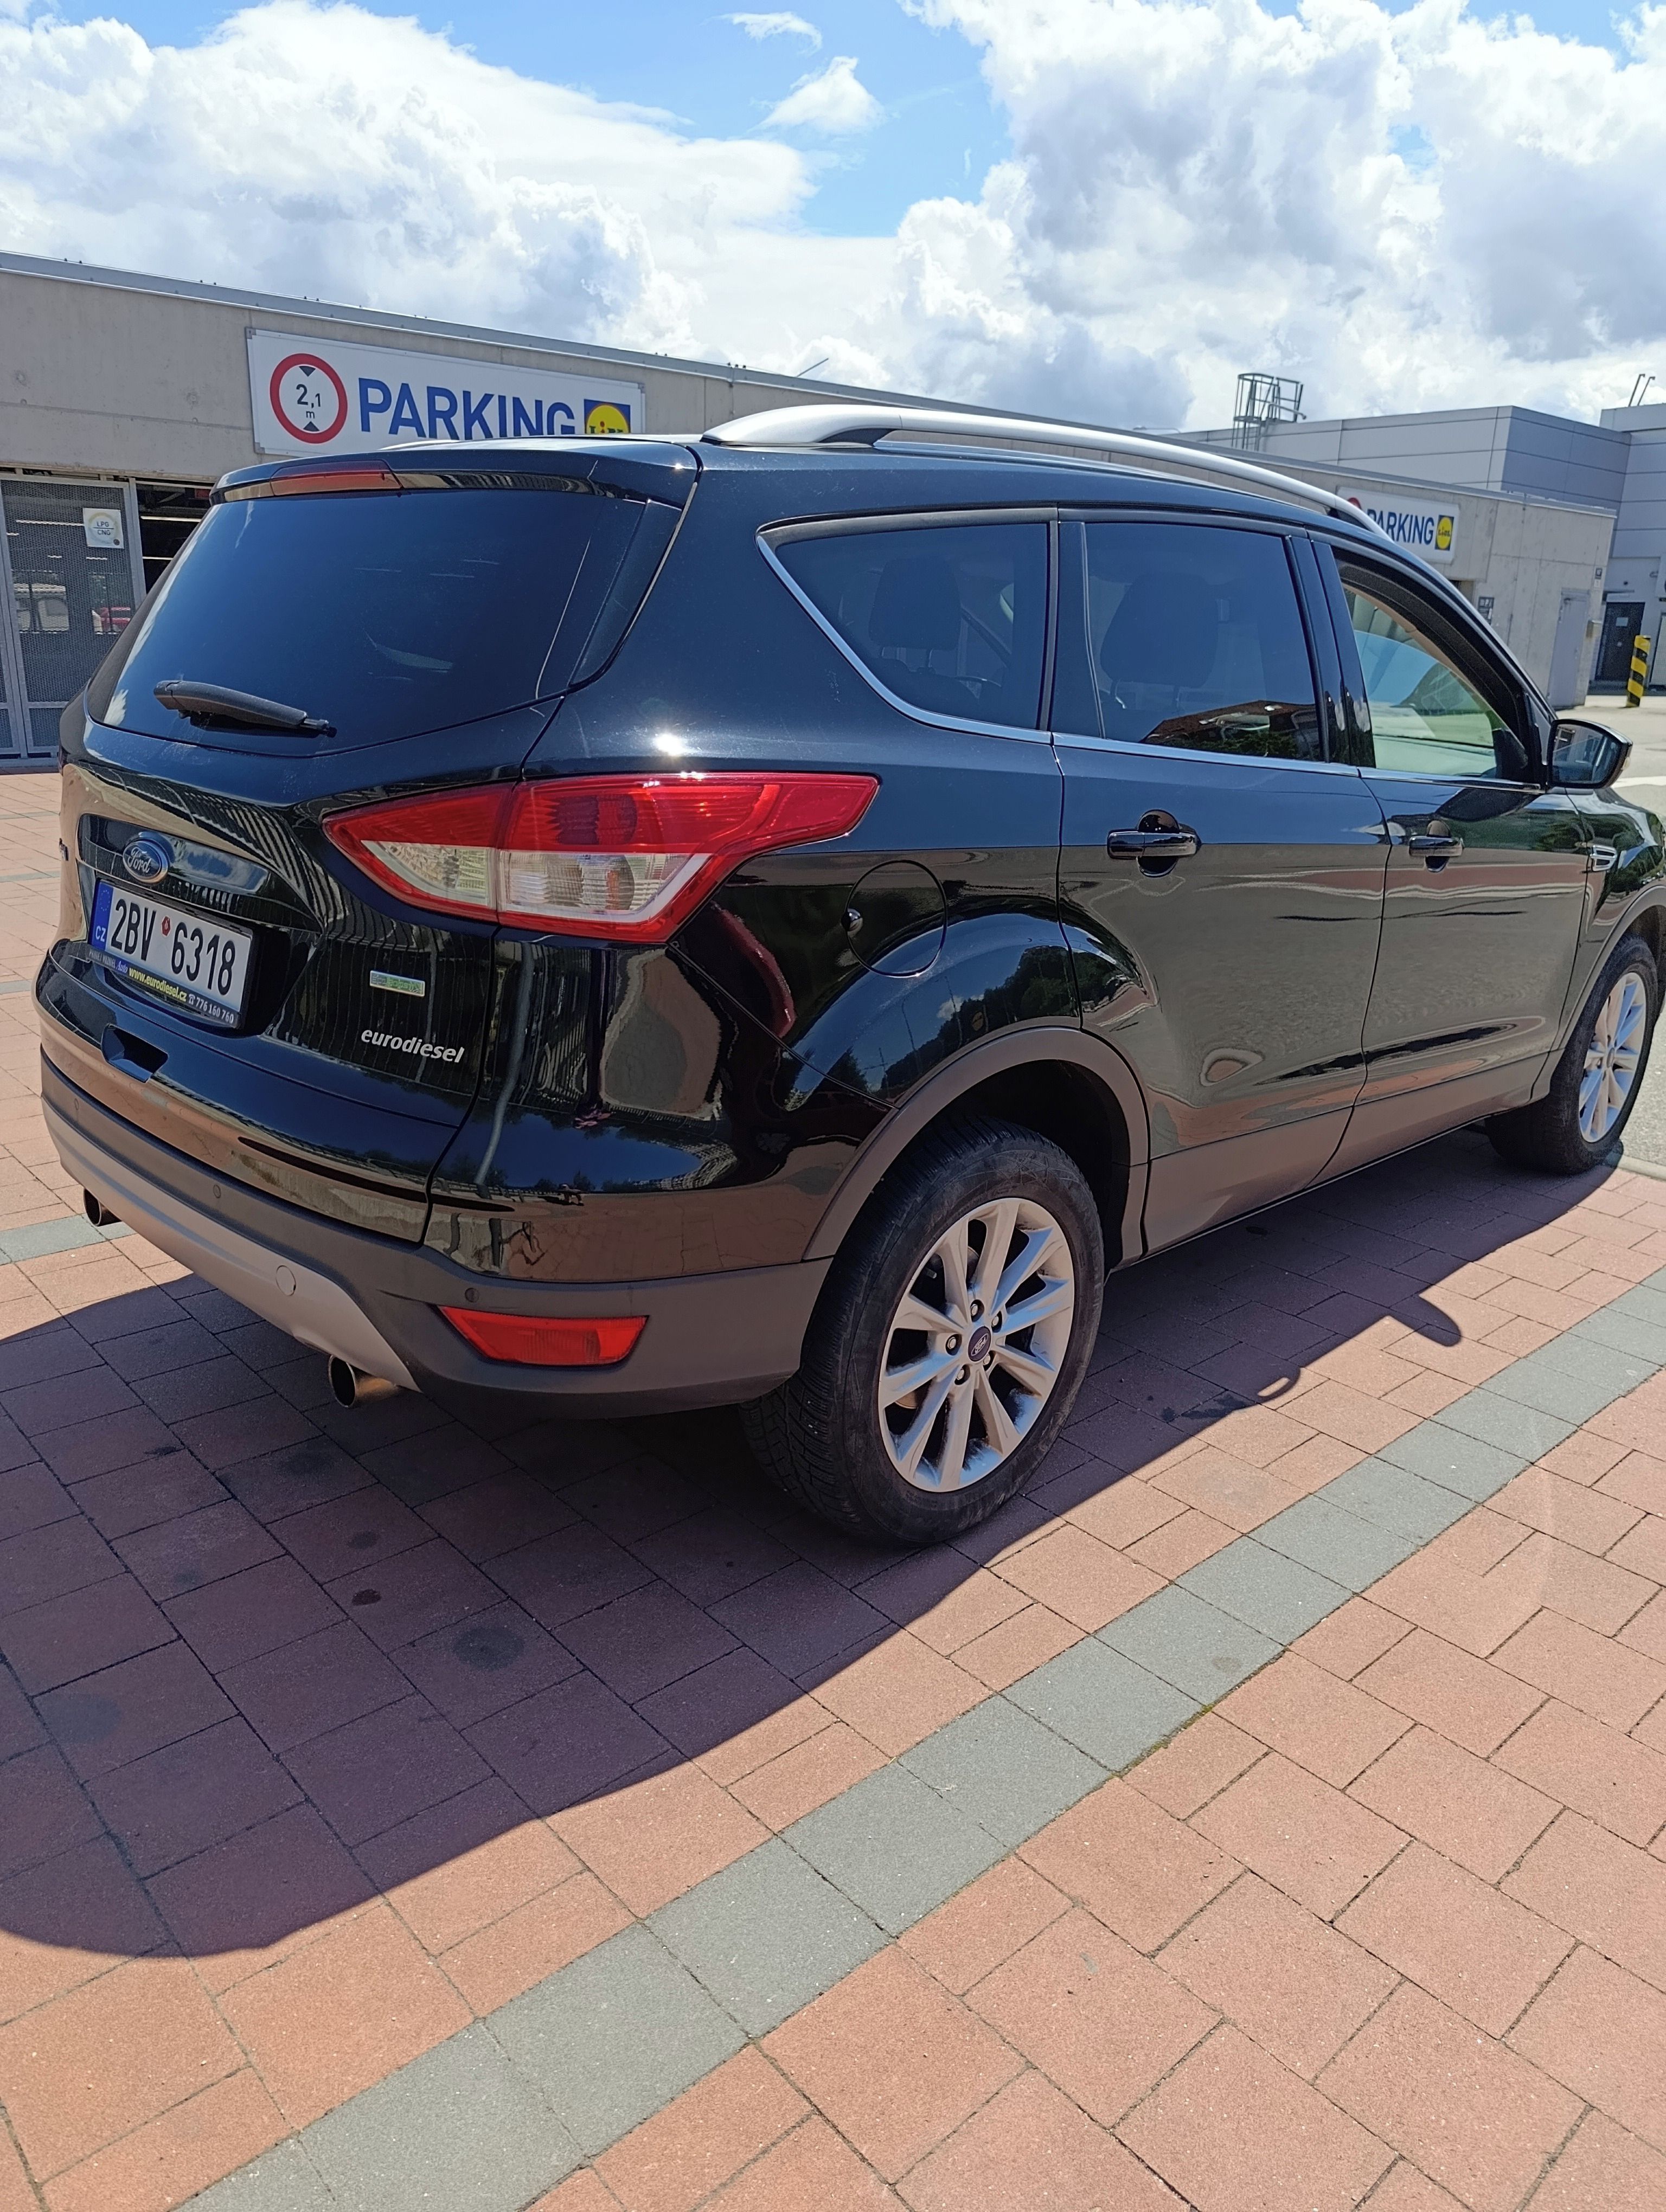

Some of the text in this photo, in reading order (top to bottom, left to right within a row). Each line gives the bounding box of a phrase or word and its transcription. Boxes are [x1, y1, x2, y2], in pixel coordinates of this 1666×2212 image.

[296, 384, 321, 408] 2,1
[358, 378, 575, 440] PARKING
[128, 847, 152, 873] Ford
[95, 925, 106, 942] CZ
[111, 899, 235, 995] 2BV 6318
[116, 961, 128, 974] Auto
[129, 968, 187, 1002] www.eurodiesel.cz
[196, 996, 208, 1012] 776
[208, 1004, 221, 1017] 160
[221, 1009, 234, 1024] 760
[361, 1030, 465, 1063] eurodiesel
